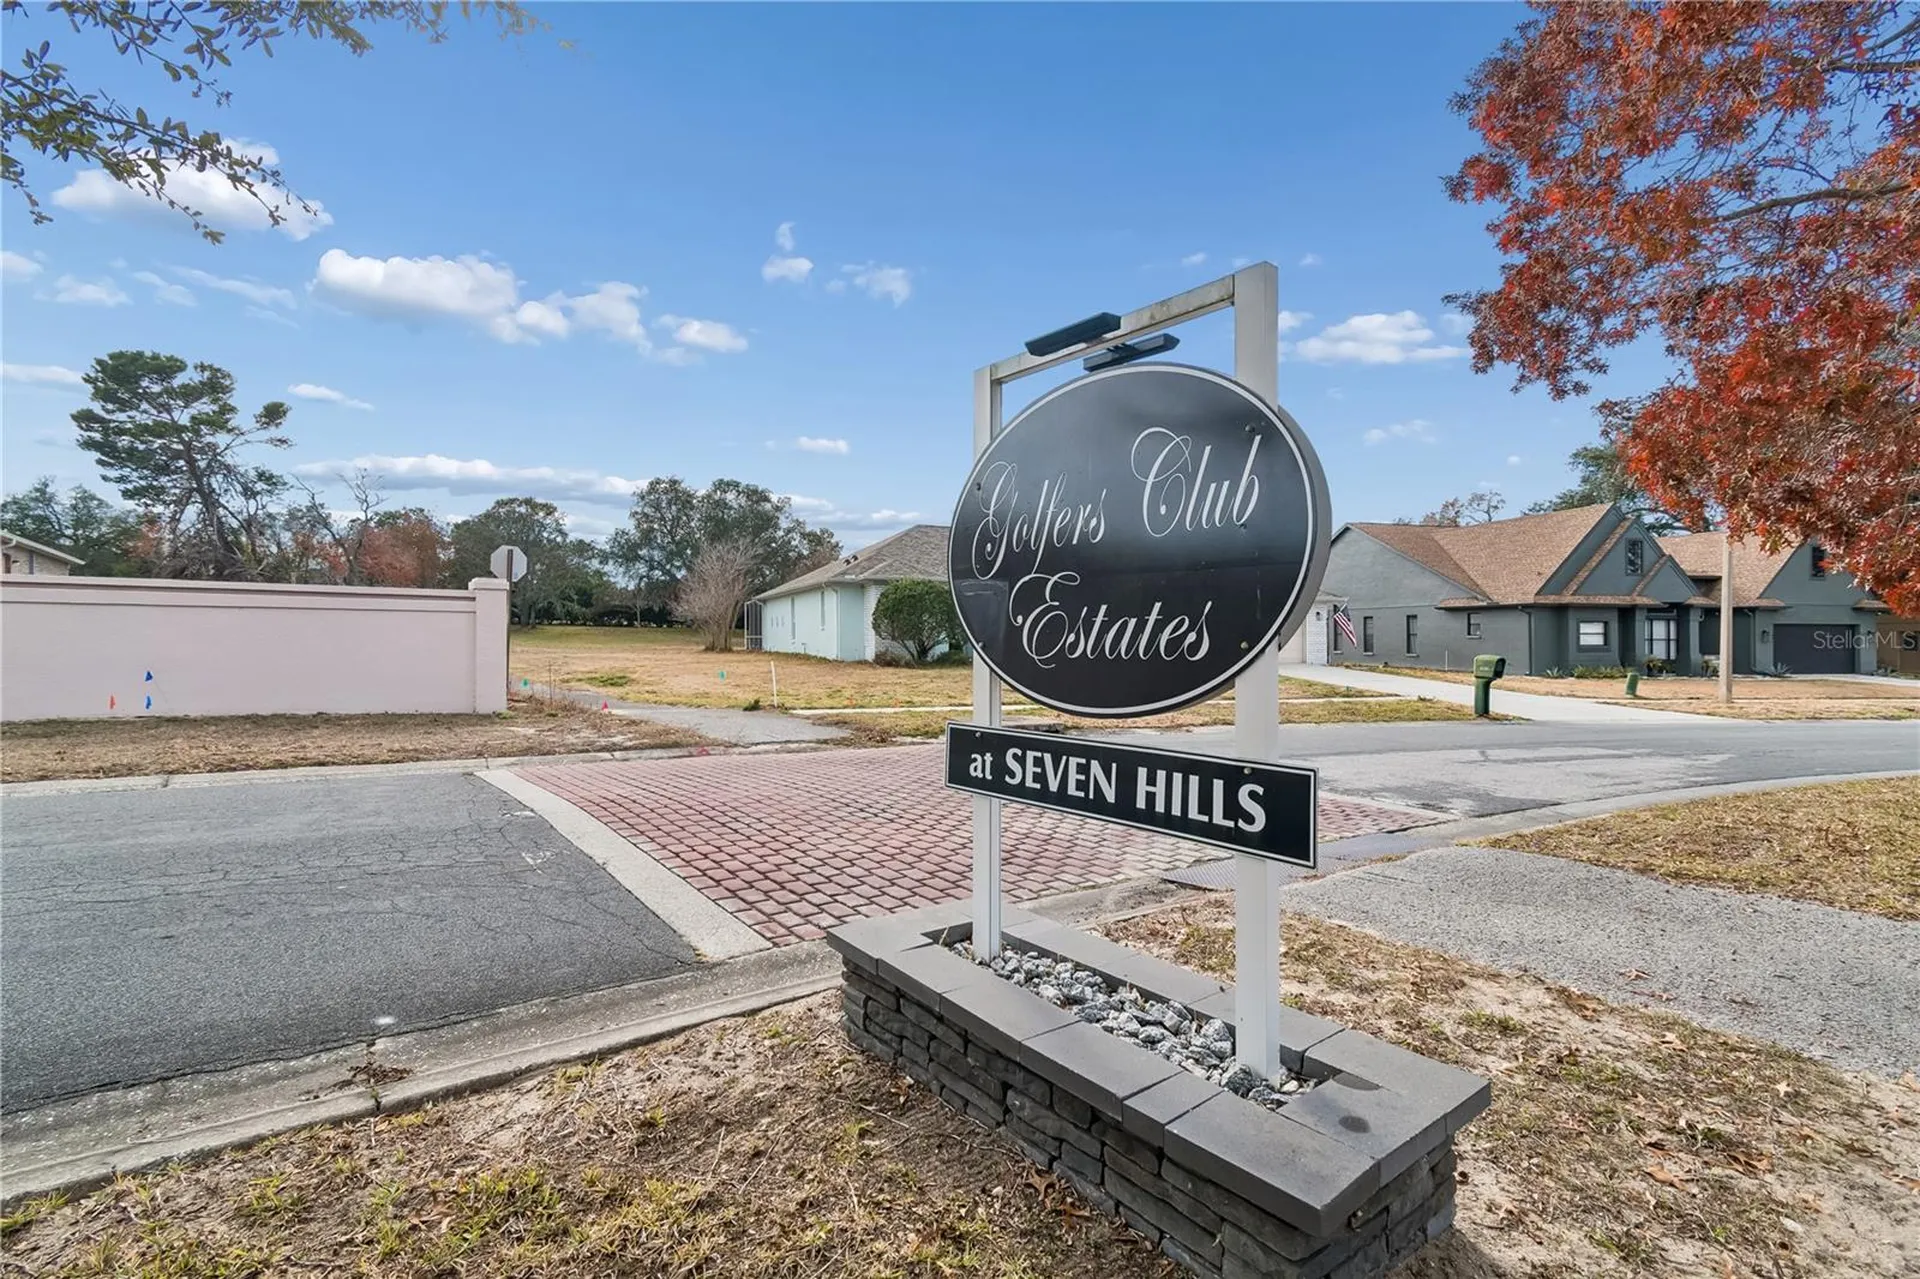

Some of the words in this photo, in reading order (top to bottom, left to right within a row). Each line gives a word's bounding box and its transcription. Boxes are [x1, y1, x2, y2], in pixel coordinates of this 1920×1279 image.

[972, 461, 1107, 580] Golfers
[1131, 427, 1262, 537] Club
[1009, 571, 1212, 668] Estates
[969, 752, 994, 780] at
[1005, 747, 1117, 803] SEVEN
[1135, 766, 1267, 833] HILLS
